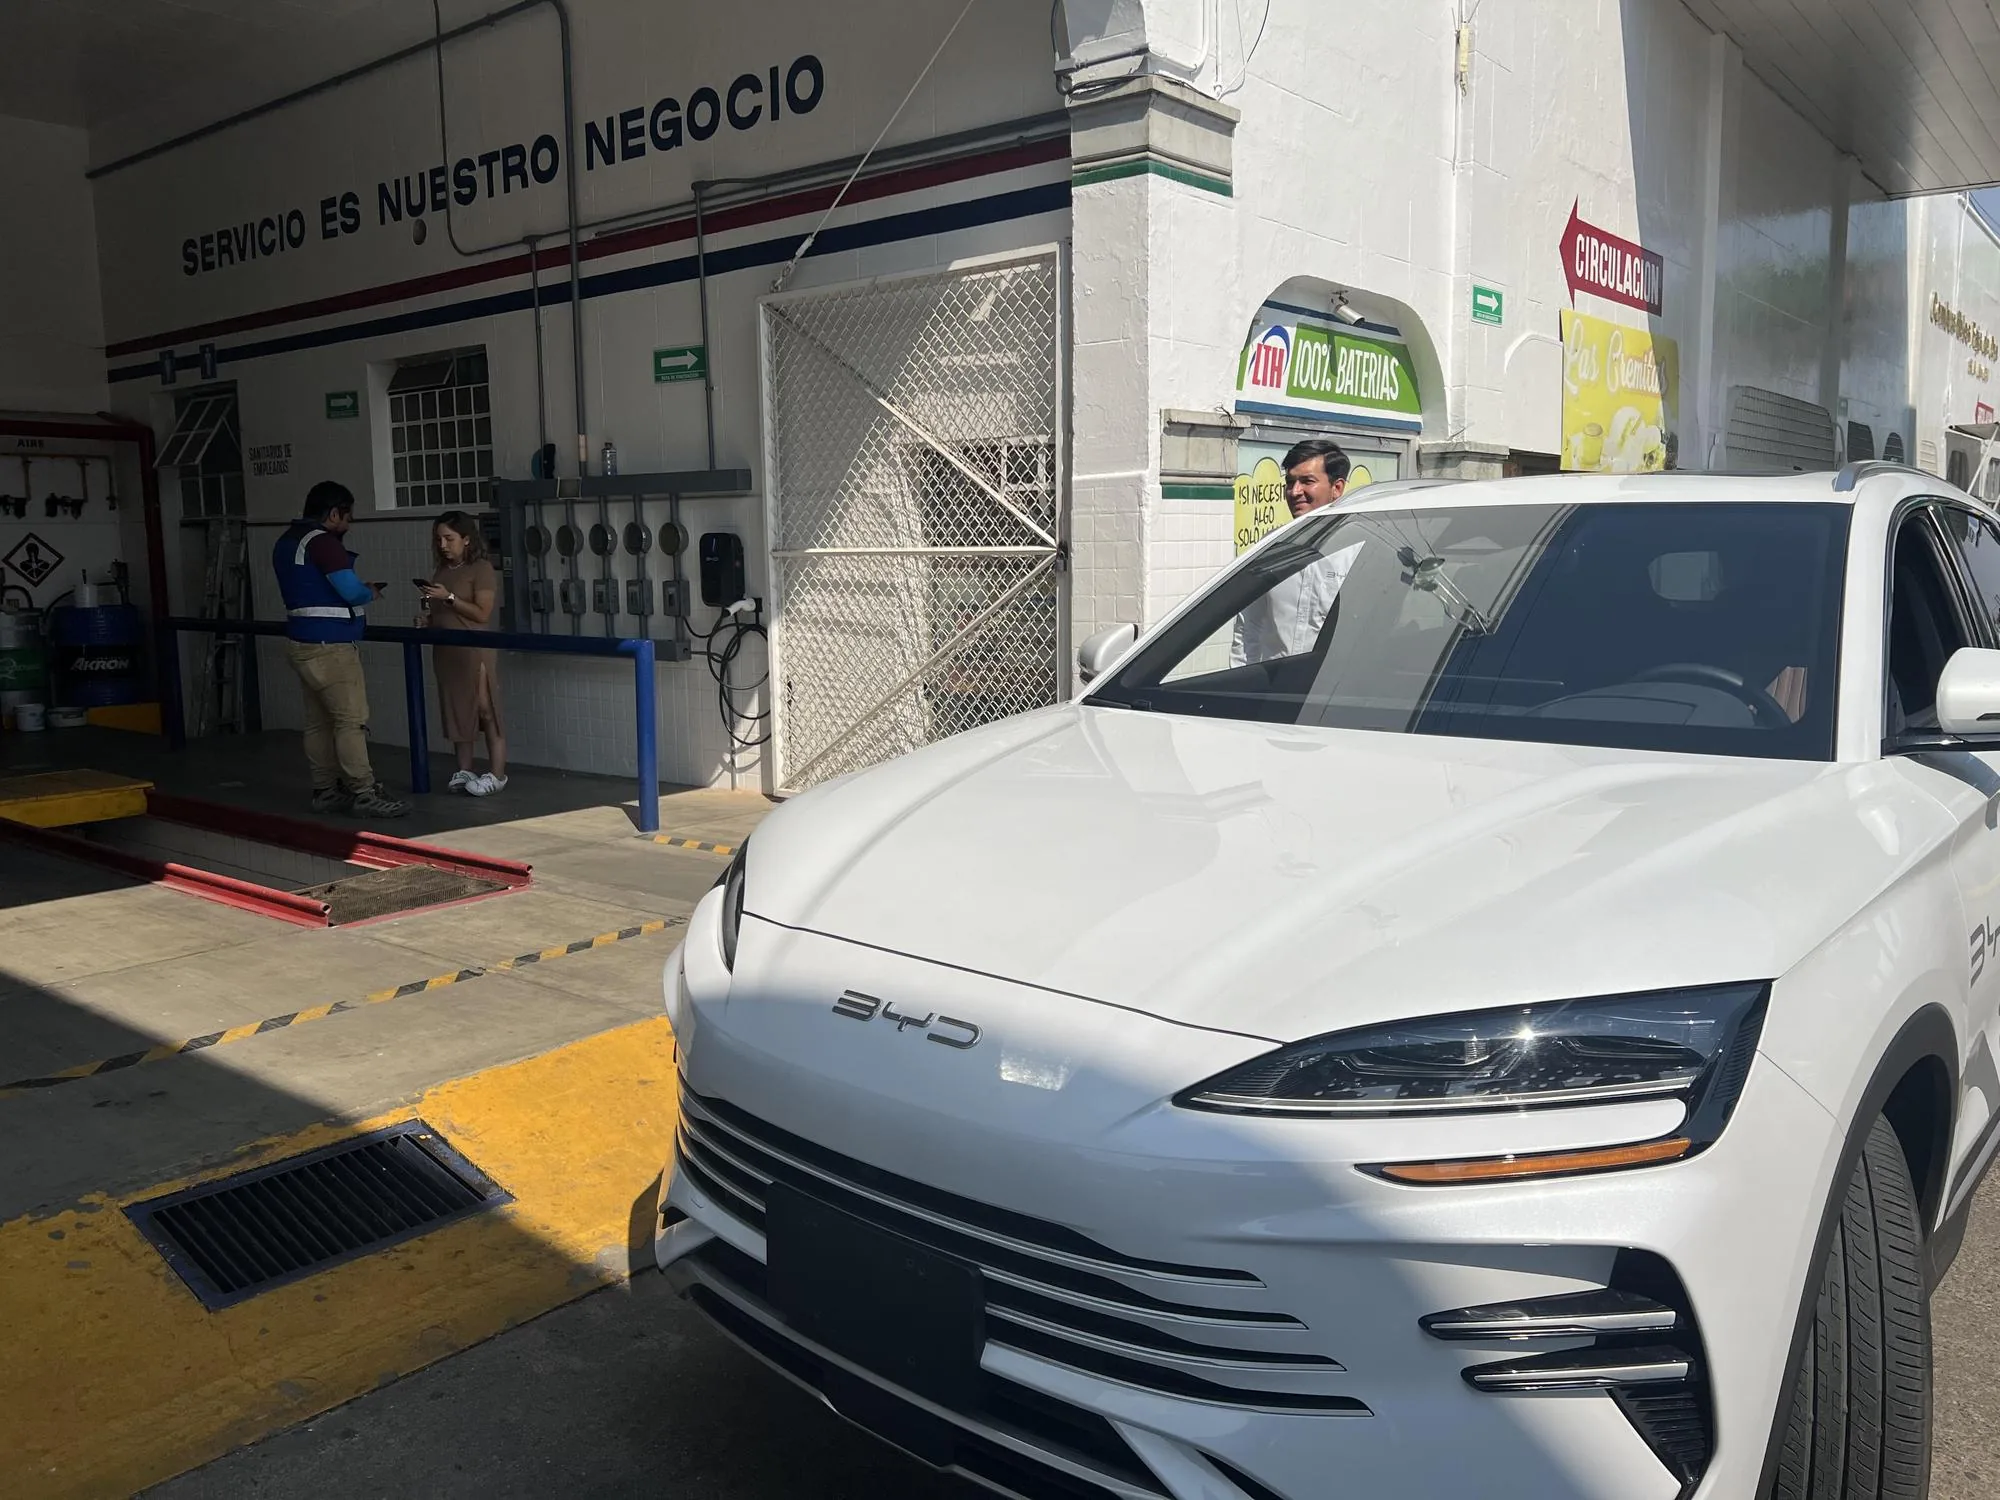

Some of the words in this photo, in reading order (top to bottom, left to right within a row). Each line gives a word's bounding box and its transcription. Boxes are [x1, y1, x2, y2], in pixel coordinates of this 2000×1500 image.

[182, 209, 305, 276] SERVICIO
[320, 191, 361, 240] ES
[378, 134, 559, 225] NUESTRO
[585, 55, 824, 171] NEGOCIO
[1575, 233, 1659, 306] CIRCULACION
[1252, 343, 1284, 388] LTH
[1293, 339, 1332, 391] 100%
[1335, 346, 1400, 401] BATERIAS
[1252, 482, 1287, 504] NECESIT
[1253, 505, 1275, 526] ALGO
[1237, 526, 1260, 548] SOLO
[70, 656, 130, 672] AKRON
[832, 989, 983, 1050] BYD
